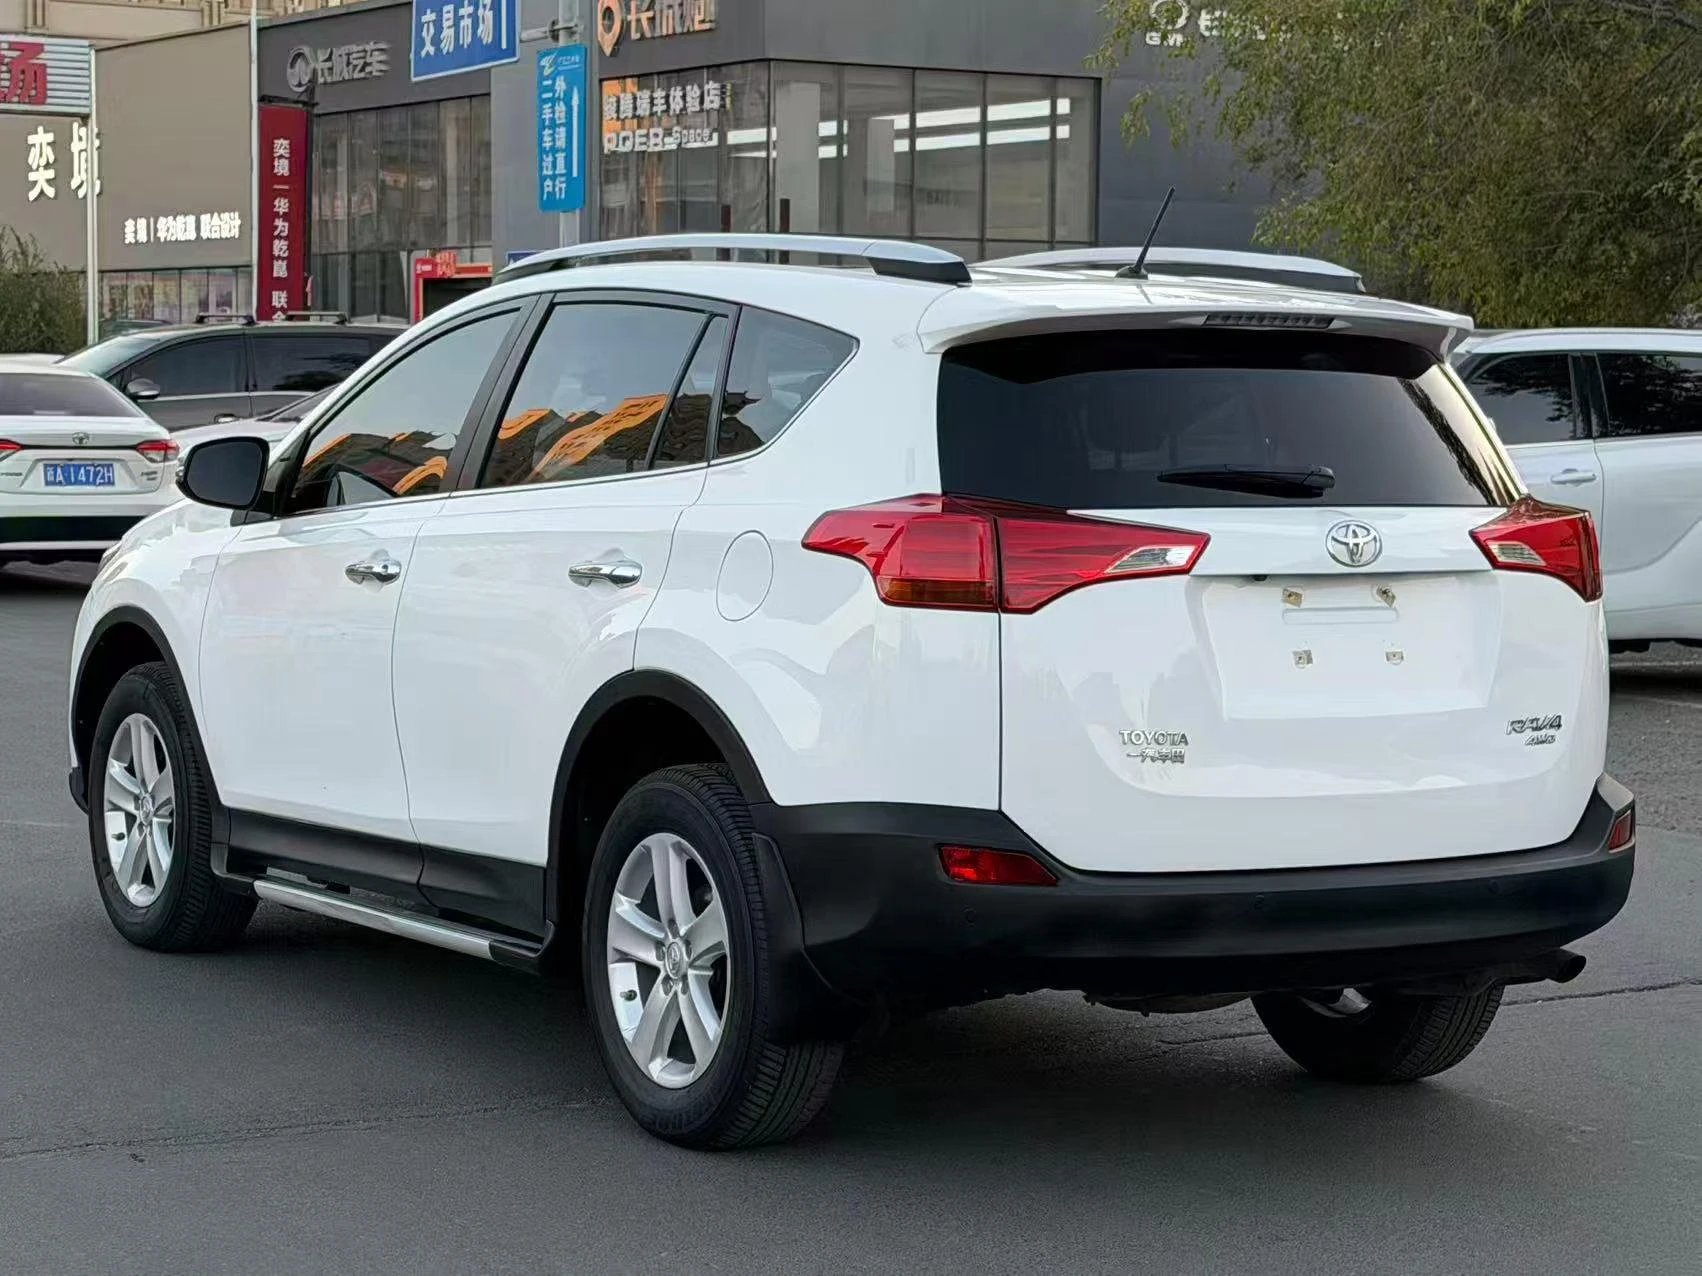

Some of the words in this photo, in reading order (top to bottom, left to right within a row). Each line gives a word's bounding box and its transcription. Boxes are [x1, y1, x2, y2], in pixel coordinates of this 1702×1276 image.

[420, 0, 494, 58] 交易市场
[541, 80, 553, 200] 二手车过户
[1119, 730, 1189, 746] TOYOTA
[1505, 714, 1563, 735] RAV4
